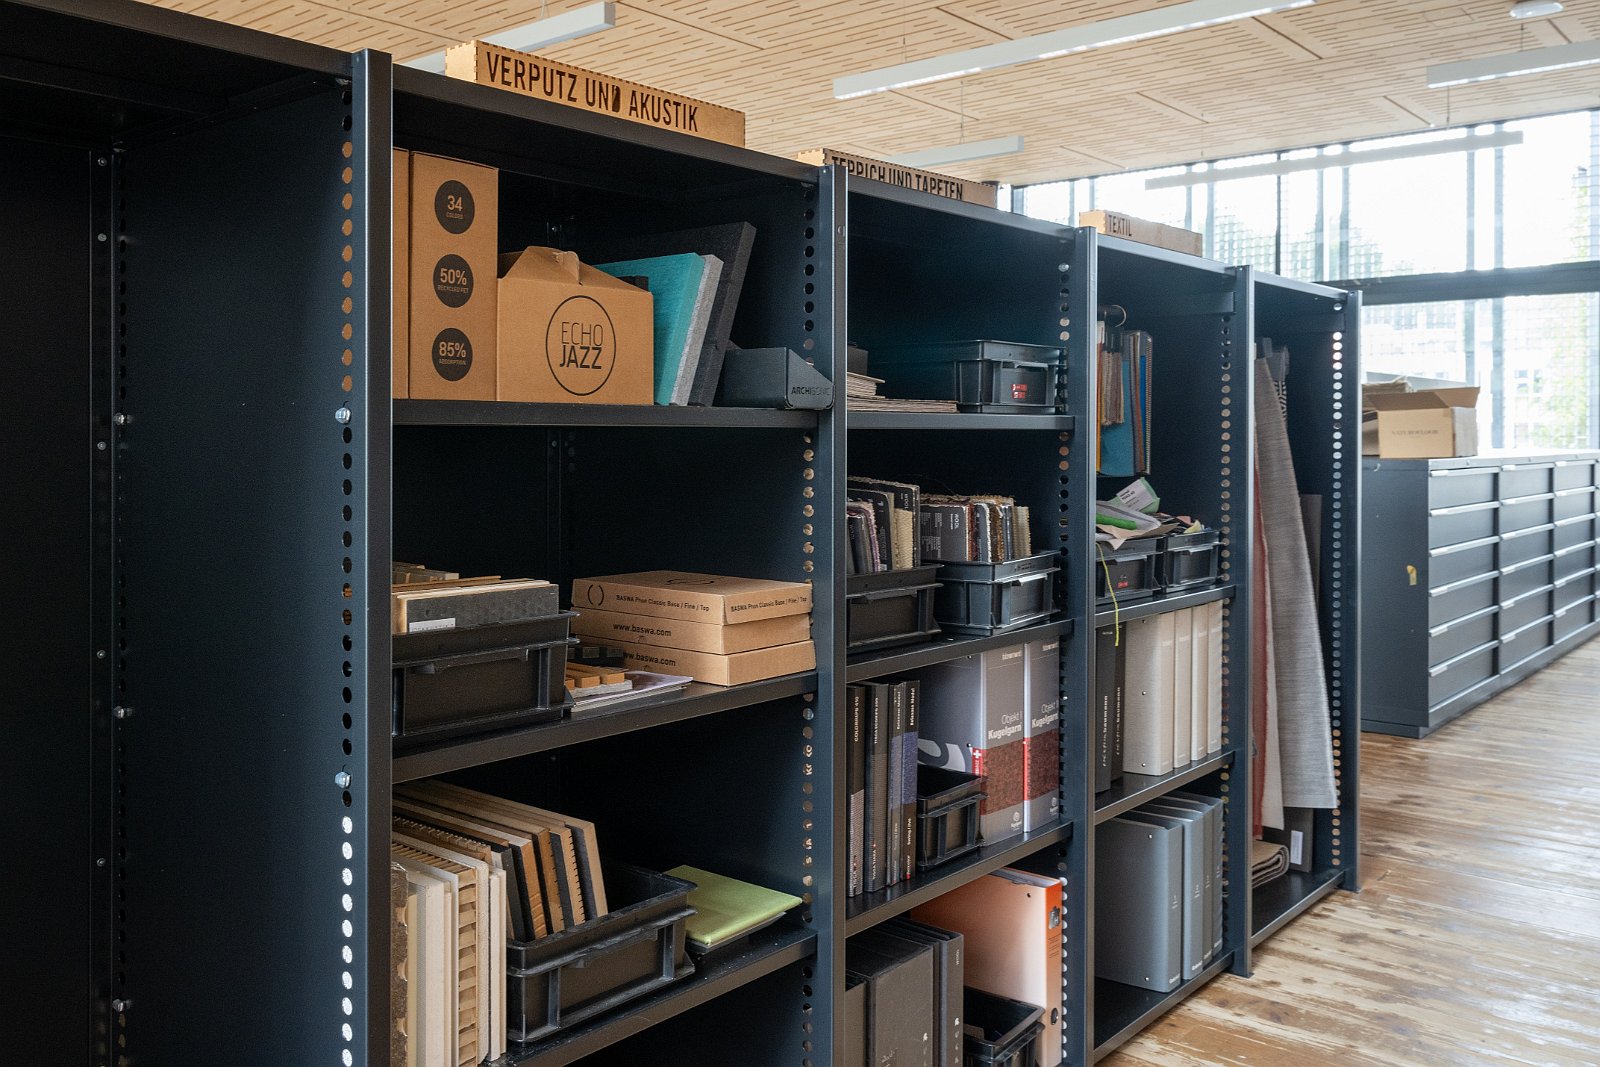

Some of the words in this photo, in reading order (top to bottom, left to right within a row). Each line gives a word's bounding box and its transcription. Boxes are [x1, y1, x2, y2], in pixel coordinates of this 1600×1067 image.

[486, 51, 578, 103] VERPUTZ
[585, 77, 621, 113] UND
[628, 89, 699, 133] AKUSTIK
[915, 173, 963, 200] TAPETEN
[447, 194, 463, 212] 34
[1108, 214, 1132, 237] TEXTIL
[440, 267, 468, 286] 50%
[561, 321, 604, 347] ECHO
[439, 341, 467, 358] 85%
[559, 344, 603, 370] JAZZ
[612, 623, 672, 637] www.baswa.com
[623, 652, 676, 667] ww.baswa.com
